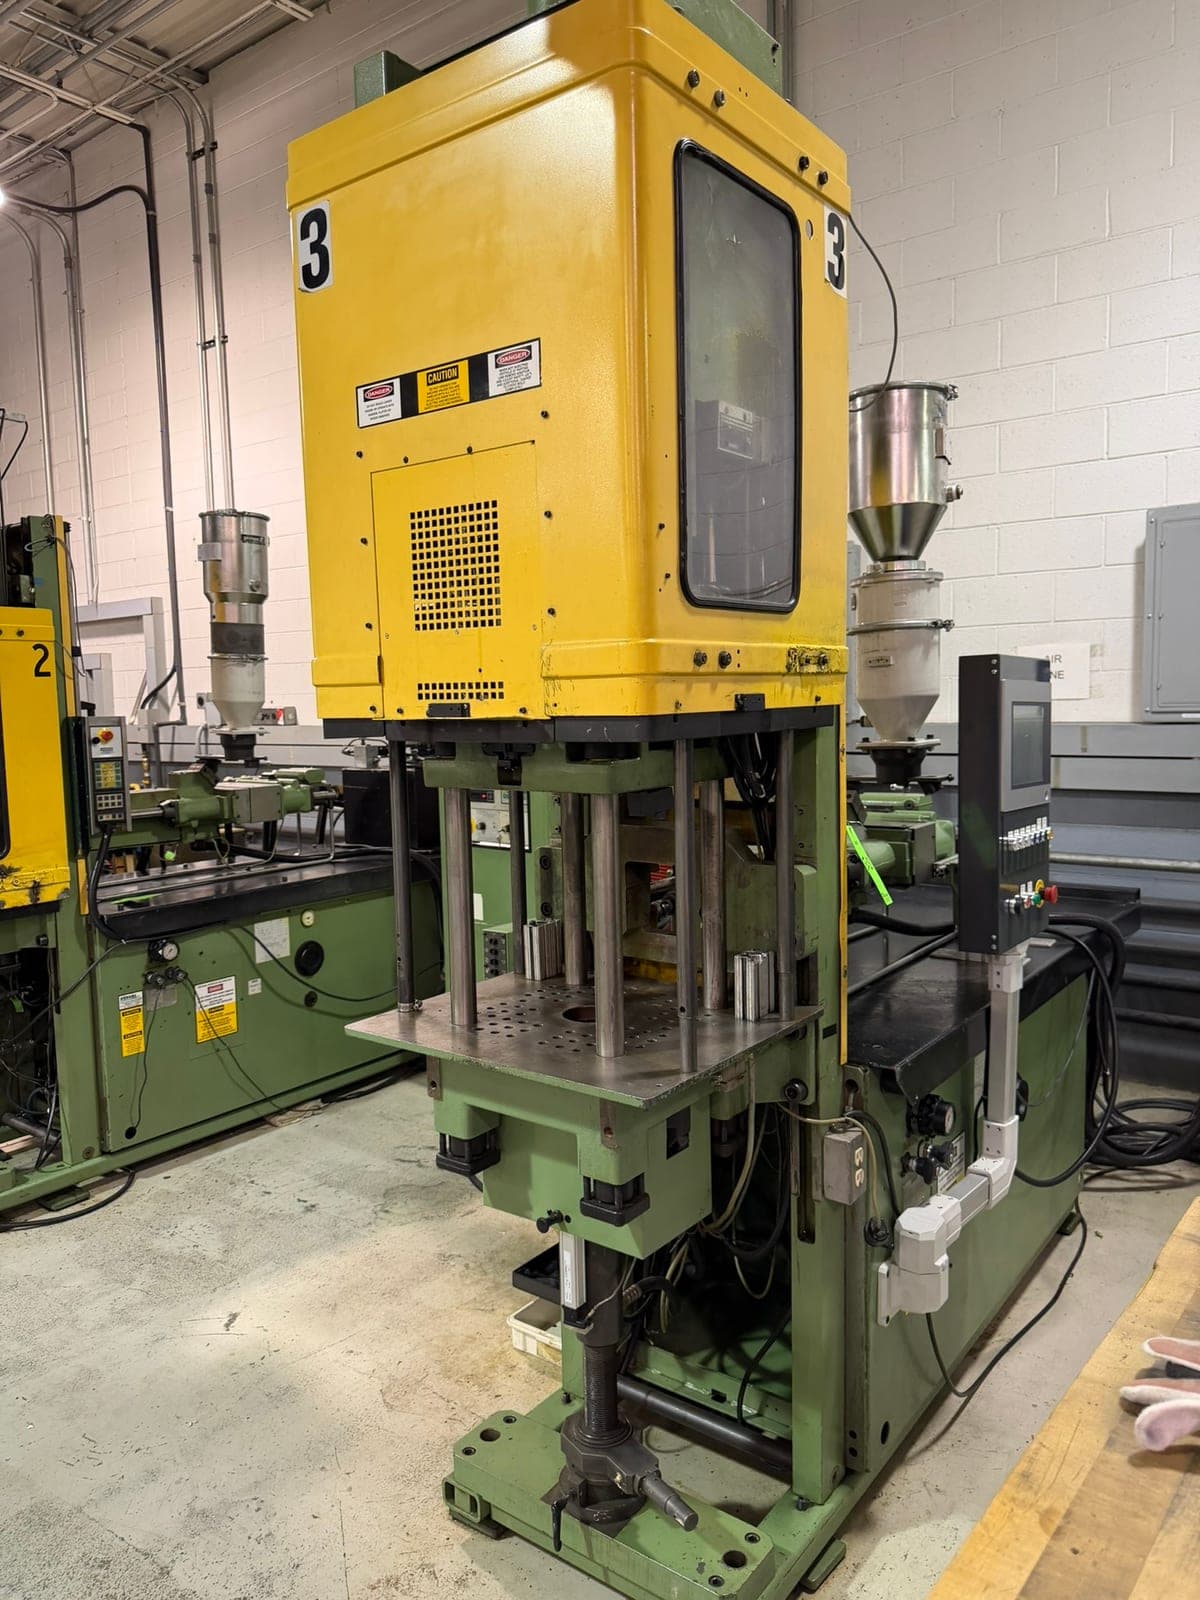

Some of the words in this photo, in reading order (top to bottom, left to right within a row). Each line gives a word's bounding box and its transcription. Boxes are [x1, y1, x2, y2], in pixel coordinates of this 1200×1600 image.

[300, 208, 330, 289] 3
[827, 212, 845, 290] 3
[499, 352, 527, 363] DANGER
[427, 368, 457, 384] CAUTION
[32, 643, 51, 677] 2
